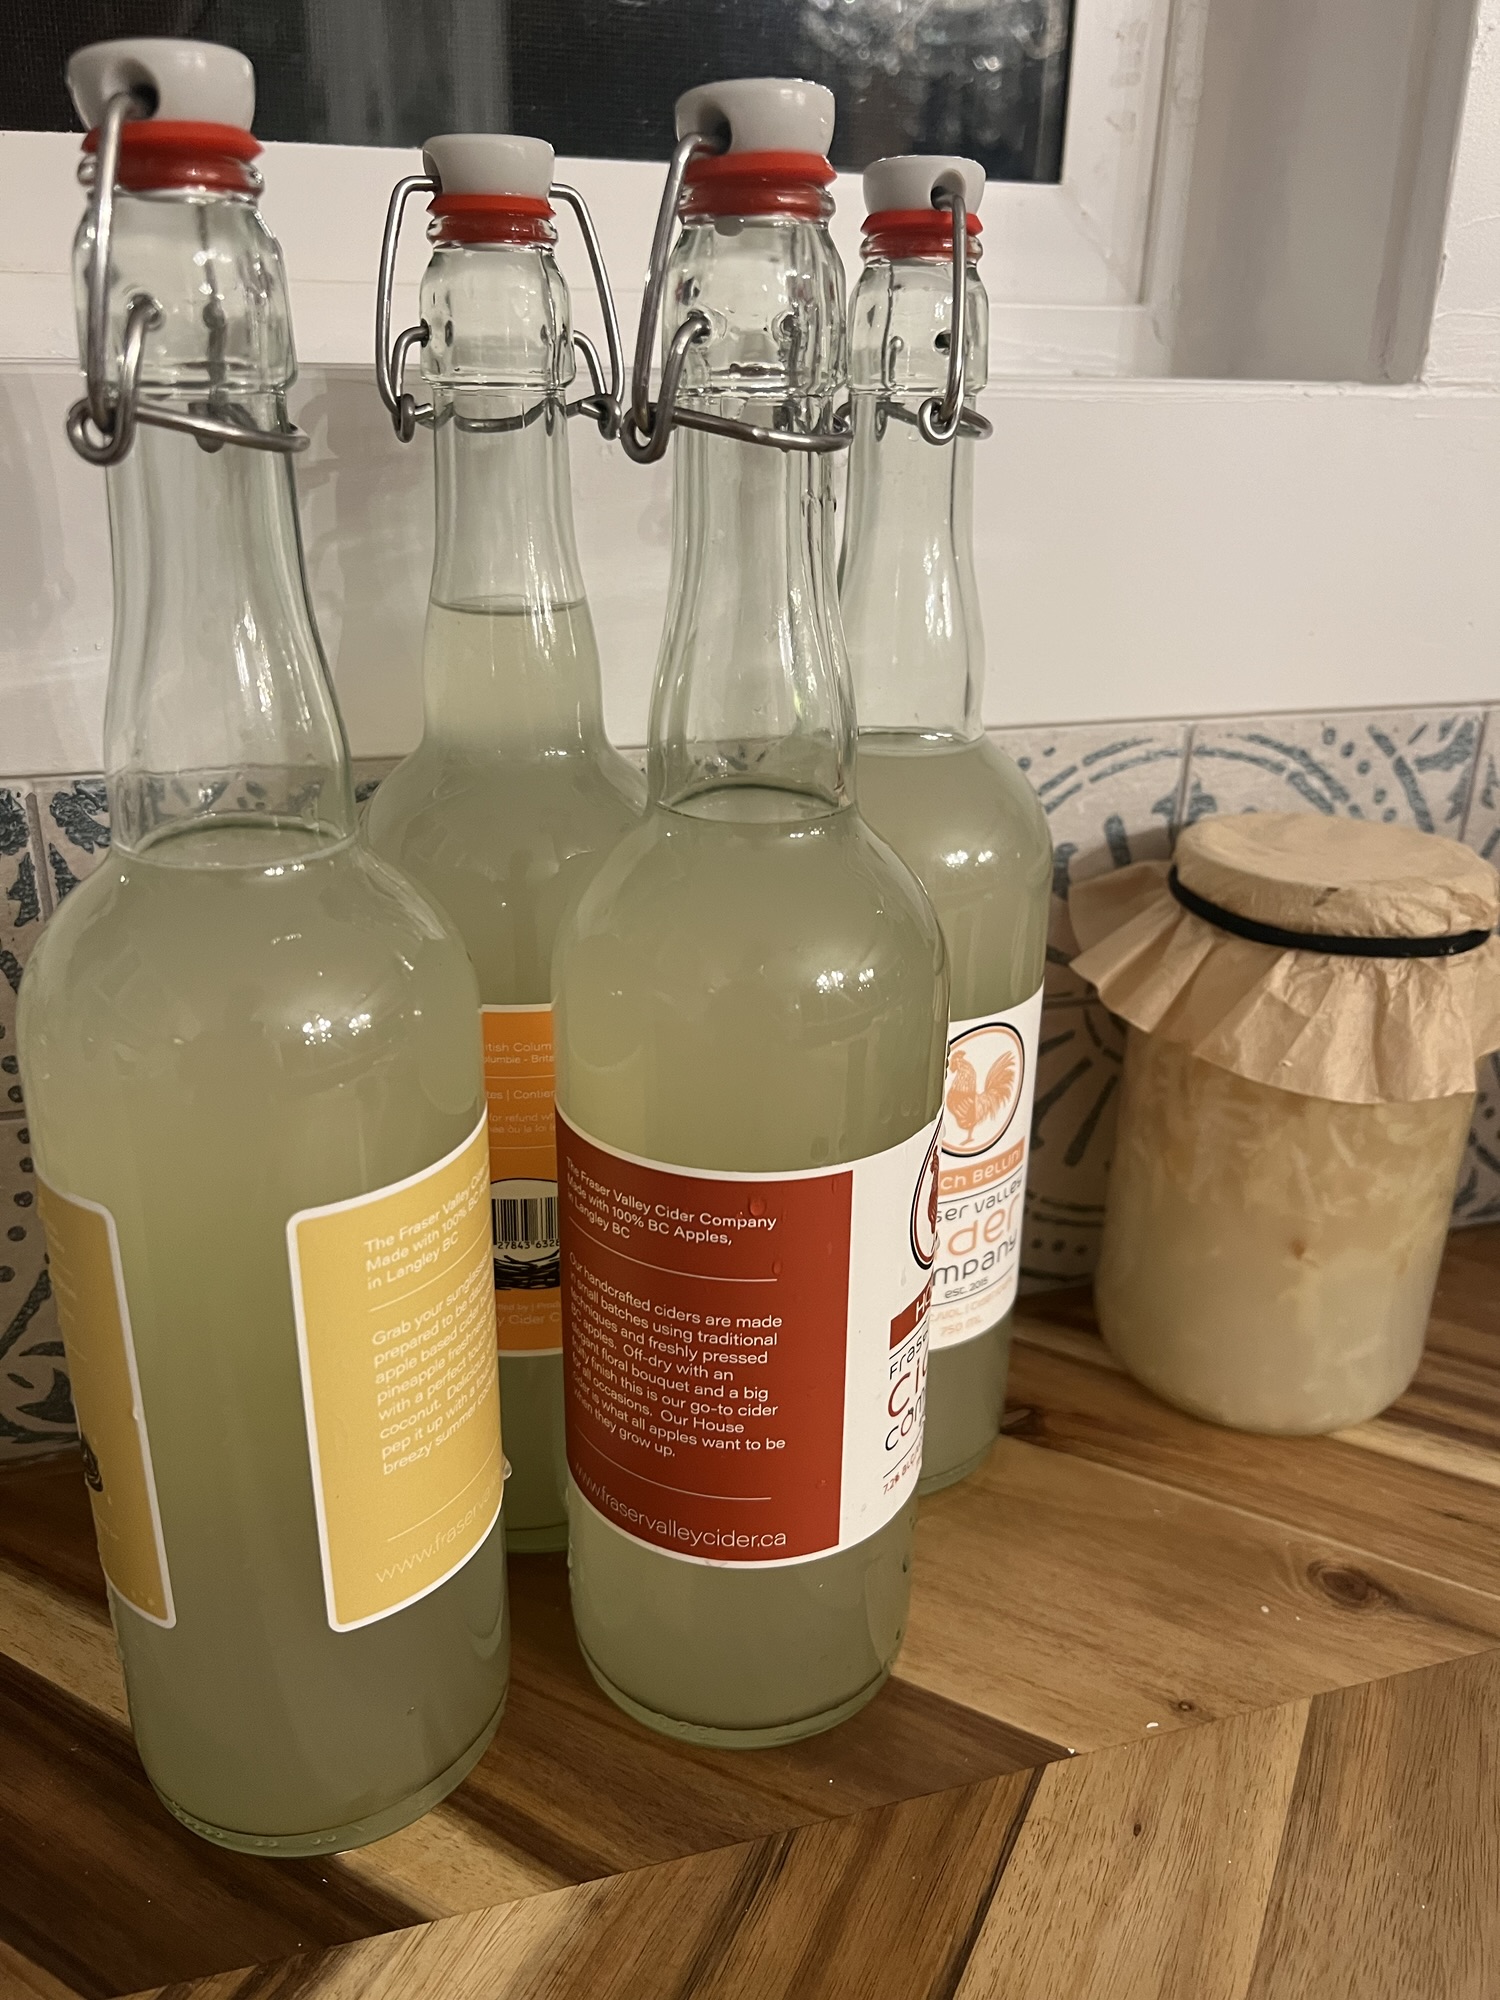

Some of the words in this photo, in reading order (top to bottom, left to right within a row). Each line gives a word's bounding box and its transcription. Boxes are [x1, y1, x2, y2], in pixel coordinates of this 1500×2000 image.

[363, 1235, 395, 1253] The
[400, 1211, 440, 1241] Fraser
[442, 1187, 470, 1215] Valley
[575, 1196, 609, 1232] Langley
[612, 1222, 630, 1239] BC
[581, 1170, 611, 1197] Fraser
[613, 1189, 651, 1216] Valley
[655, 1204, 695, 1222] Cider
[699, 1212, 777, 1231] Company
[588, 1194, 609, 1214] with
[612, 1206, 645, 1228] 100%
[648, 1219, 670, 1235] BC
[673, 1226, 732, 1246] Apples,
[366, 1247, 409, 1272] Made
[412, 1230, 440, 1252] with
[442, 1206, 468, 1234] 100%
[367, 1277, 382, 1291] in
[387, 1248, 440, 1283] Langley
[442, 1231, 459, 1252] BC
[497, 1241, 530, 1250] 27843
[372, 1316, 411, 1345] Grab
[414, 1301, 443, 1331] your
[571, 1286, 618, 1333] techniques
[620, 1328, 645, 1345] and
[648, 1335, 698, 1362] freshly
[703, 1351, 768, 1364] pressed
[577, 1279, 599, 1304] small
[601, 1295, 649, 1329] batches
[652, 1322, 693, 1343] using
[697, 1330, 778, 1346] traditional
[583, 1265, 651, 1312] handcrafted
[653, 1304, 701, 1324] ciders
[705, 1315, 731, 1327] are
[736, 1314, 783, 1328] made
[374, 1319, 439, 1369] prepared
[442, 1313, 453, 1329] to
[456, 1300, 468, 1318] be
[376, 1357, 417, 1384] apple
[421, 1325, 457, 1361] based
[583, 1319, 617, 1350] apples.
[623, 1344, 672, 1373] Off-dry
[676, 1364, 709, 1379] with
[713, 1370, 734, 1381] an
[377, 1357, 446, 1407] pineapple
[379, 1398, 411, 1420] with
[414, 1392, 423, 1404] a
[427, 1356, 467, 1400] perfect
[591, 1356, 618, 1384] finish
[621, 1376, 644, 1396] this
[646, 1385, 658, 1401] is
[661, 1395, 686, 1409] our
[690, 1401, 734, 1415] go-to
[738, 1403, 779, 1416] cider
[592, 1377, 653, 1417] occasions.
[660, 1409, 689, 1426] Our
[693, 1416, 745, 1433] House
[601, 1347, 628, 1373] floral
[632, 1363, 690, 1393] bouquet
[694, 1385, 724, 1398] and
[729, 1388, 739, 1399] a
[744, 1386, 768, 1402] big
[382, 1437, 411, 1461] pep
[414, 1427, 424, 1440] it
[427, 1416, 443, 1433] up
[445, 1394, 468, 1419] with
[469, 1386, 476, 1398] a
[384, 1441, 433, 1475] breezy
[435, 1402, 477, 1446] summer
[591, 1388, 600, 1404] is
[601, 1399, 629, 1423] what
[631, 1417, 646, 1431] all
[648, 1424, 698, 1445] apples
[702, 1438, 741, 1450] want
[745, 1439, 761, 1450] to
[765, 1438, 786, 1450] be
[594, 1408, 617, 1433] they
[619, 1428, 651, 1449] grow
[654, 1443, 676, 1458] up.
